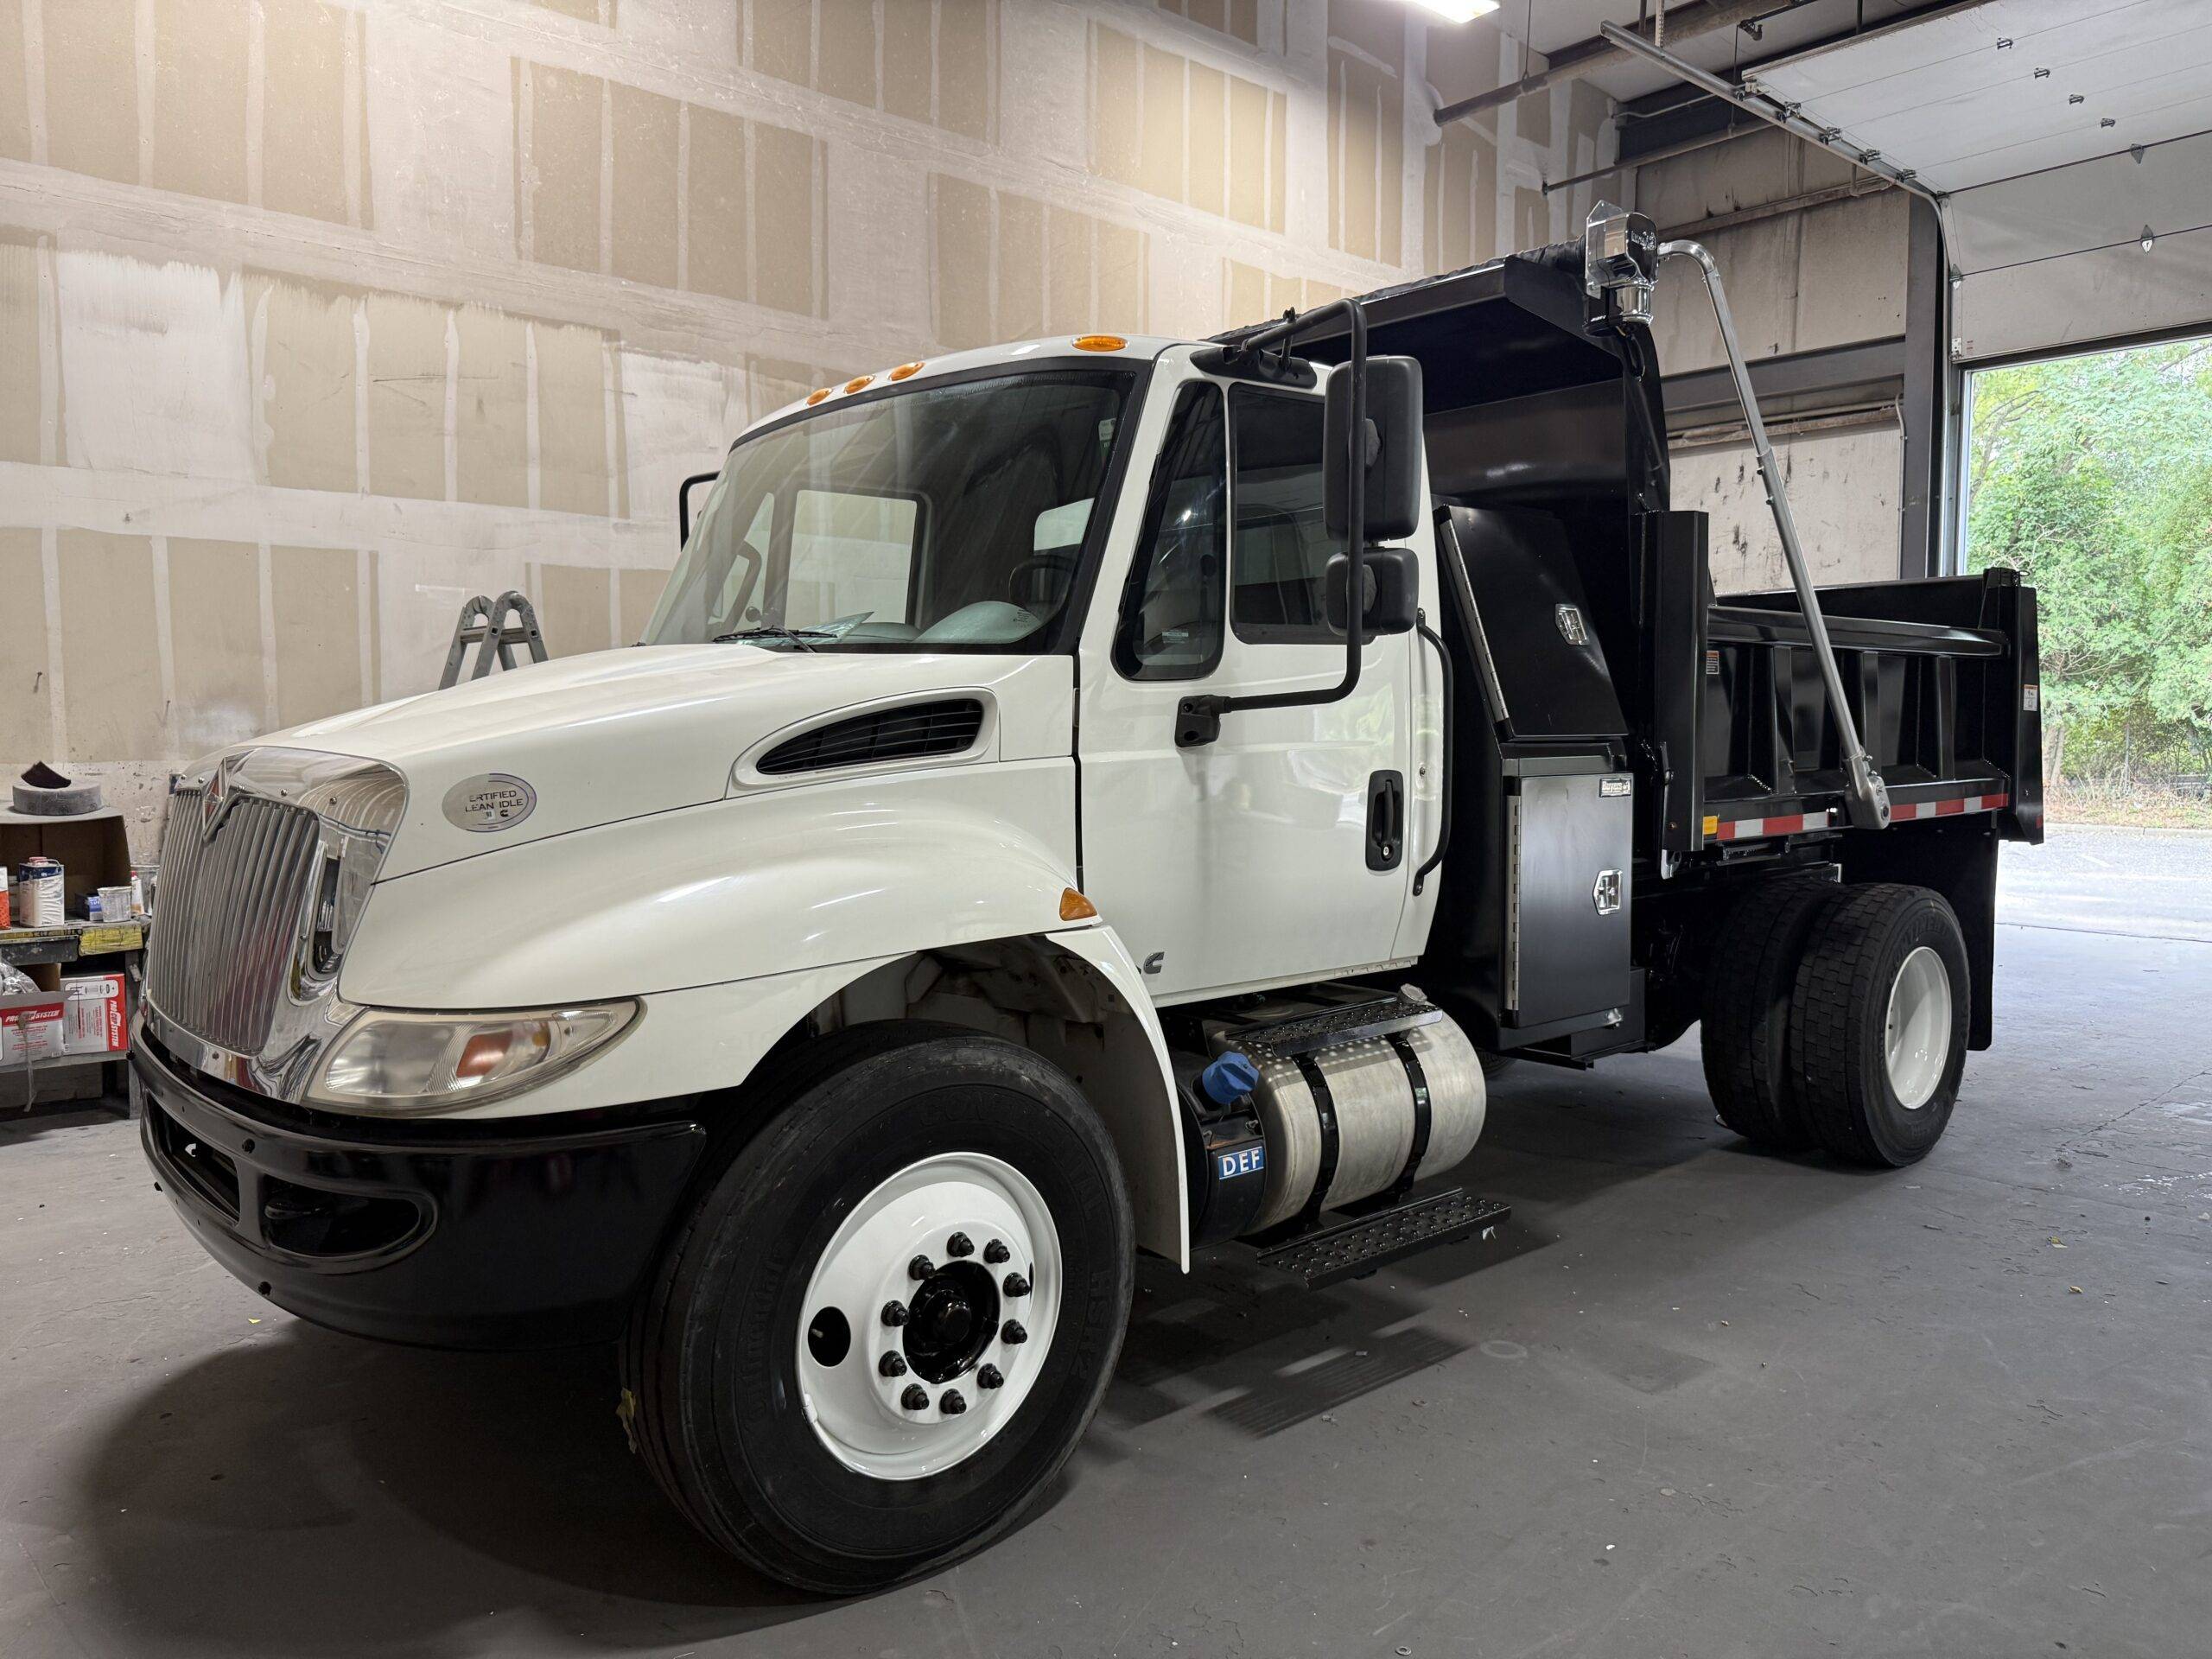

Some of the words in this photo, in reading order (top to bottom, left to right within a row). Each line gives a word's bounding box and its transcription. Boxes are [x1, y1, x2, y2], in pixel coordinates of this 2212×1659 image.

[469, 790, 517, 802] ERTIFIED
[465, 802, 494, 812] LEAN
[499, 798, 524, 808] IDLE
[1222, 1149, 1260, 1176] DEF
